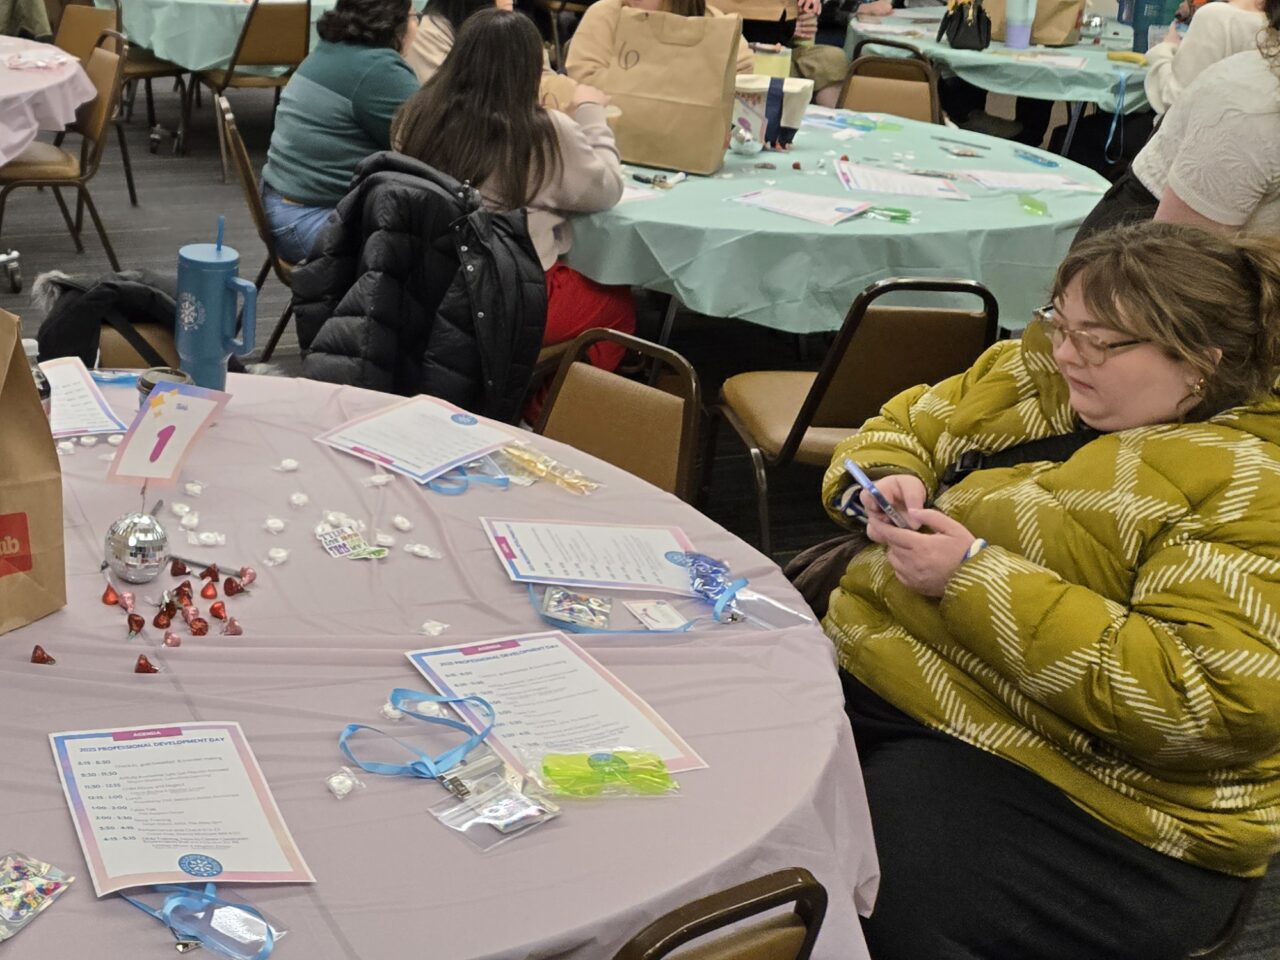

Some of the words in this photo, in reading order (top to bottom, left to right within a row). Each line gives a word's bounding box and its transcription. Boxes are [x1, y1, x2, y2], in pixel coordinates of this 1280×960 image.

[618, 41, 640, 71] 6
[149, 424, 177, 463] 1
[97, 743, 151, 752] PROFESSIONAL
[153, 737, 208, 748] DEVELOPMENT
[208, 736, 225, 744] DAY
